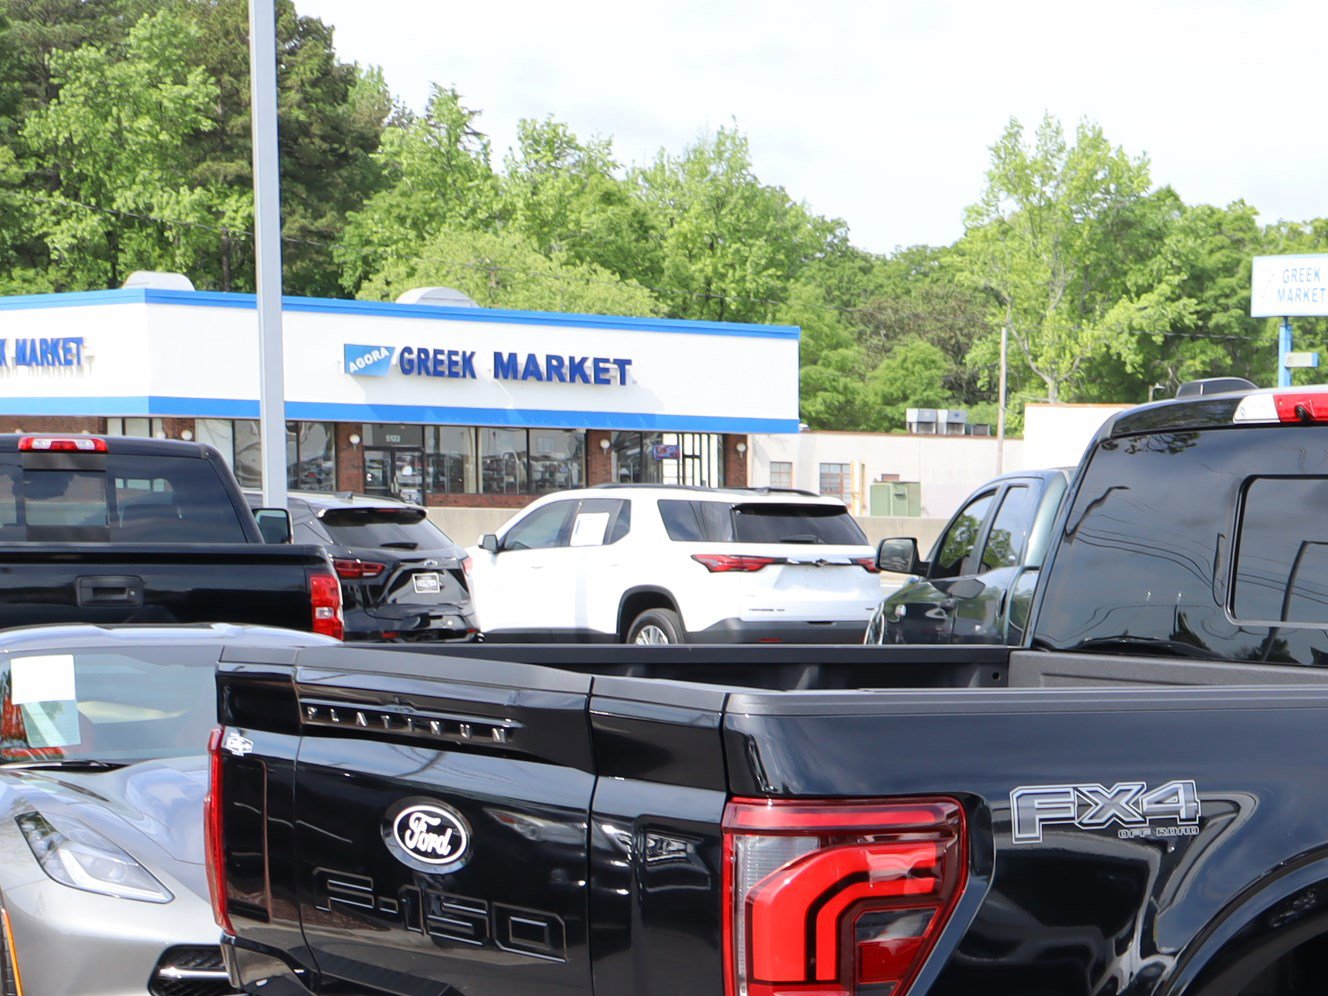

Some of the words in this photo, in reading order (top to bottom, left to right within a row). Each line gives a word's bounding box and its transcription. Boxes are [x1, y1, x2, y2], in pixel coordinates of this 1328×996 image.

[1277, 287, 1327, 303] MARKET
[1283, 267, 1321, 284] GREEK
[15, 336, 83, 366] MARKET
[349, 346, 390, 373] AGORA
[399, 345, 477, 379] GREEK
[493, 351, 632, 385] MARKET
[306, 706, 510, 744] PLATINUM
[1009, 779, 1202, 844] FX4
[404, 811, 452, 856] Ford
[312, 866, 568, 964] F-150
